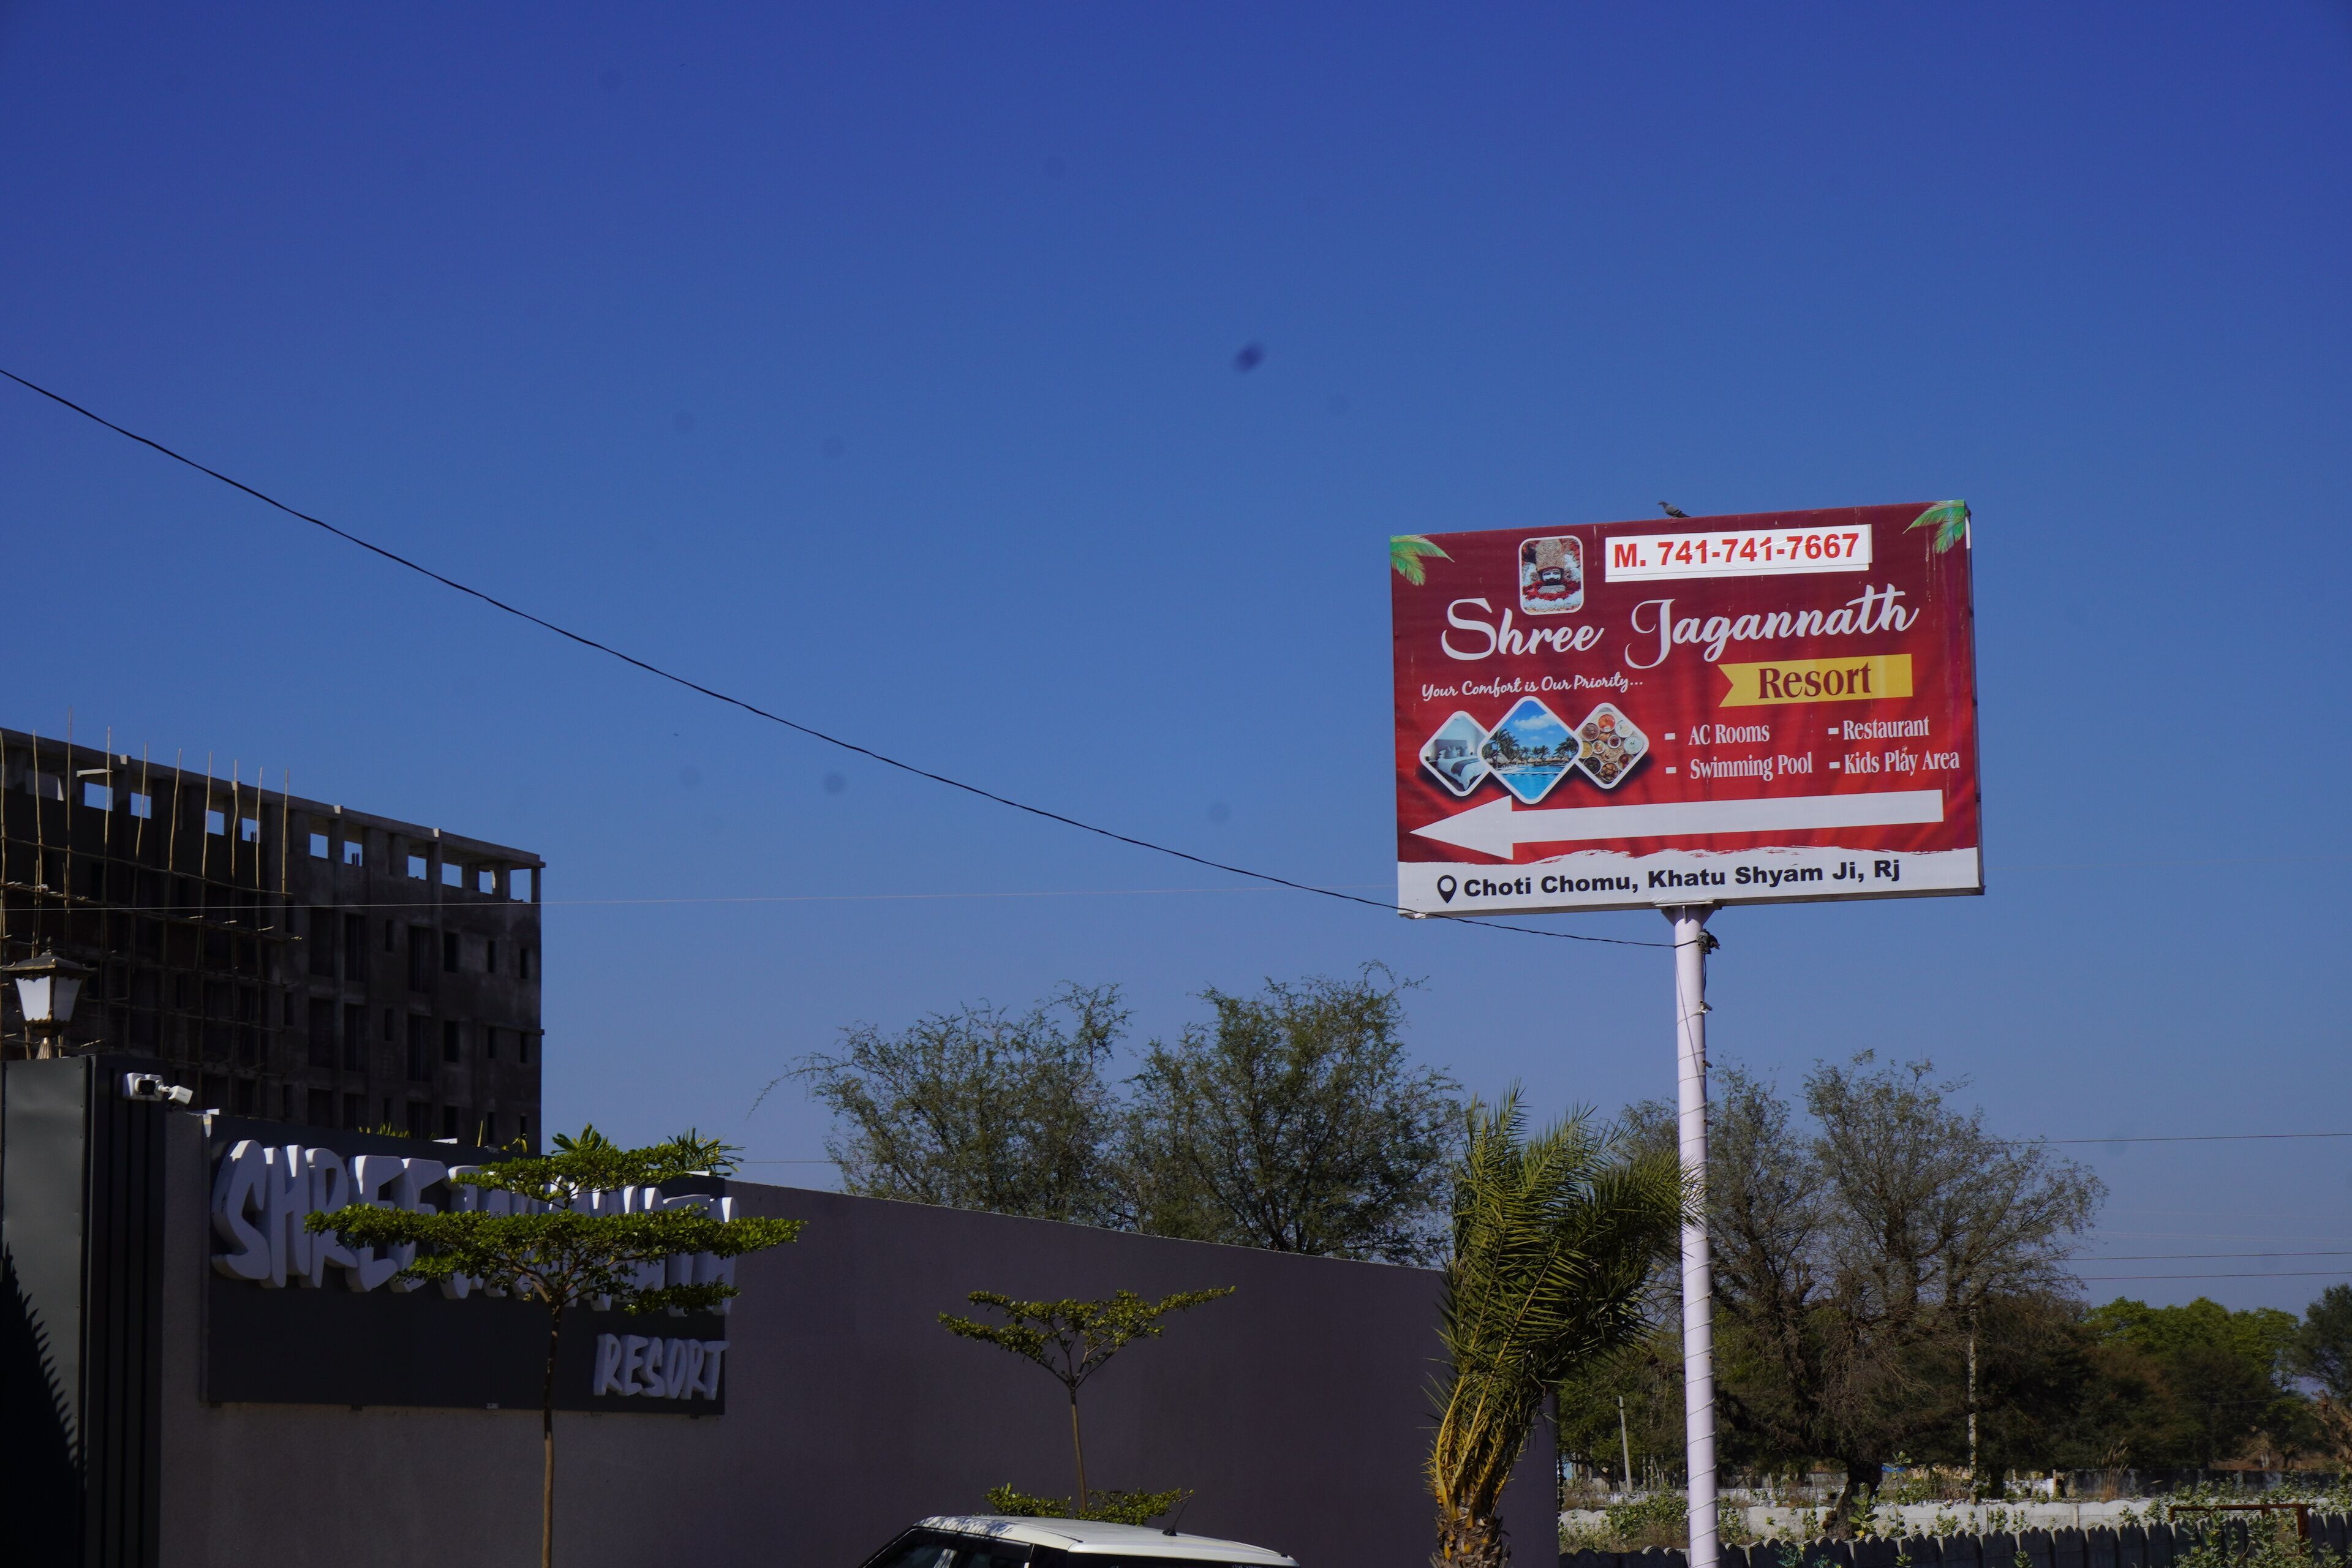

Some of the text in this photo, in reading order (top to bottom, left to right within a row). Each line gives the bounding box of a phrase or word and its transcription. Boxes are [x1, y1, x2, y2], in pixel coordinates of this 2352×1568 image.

[1614, 533, 1860, 568] M. 741-741-7667
[1441, 583, 1920, 669] Shree Jagannath
[1422, 684, 1458, 701] Your
[1461, 676, 1522, 698] Comfort
[1524, 678, 1539, 693] is
[1541, 675, 1572, 692] Our
[1758, 662, 1872, 699] Resort
[1688, 724, 1770, 745] AC Rooms
[1843, 715, 1930, 740] Restaurant
[1690, 751, 1812, 782] Swimming Pool
[1844, 747, 1960, 776] Kids Play Area
[1464, 859, 1899, 897] Choti Chomu, Khatu Shyam Ji, Rj
[594, 1333, 731, 1400] RESORT
